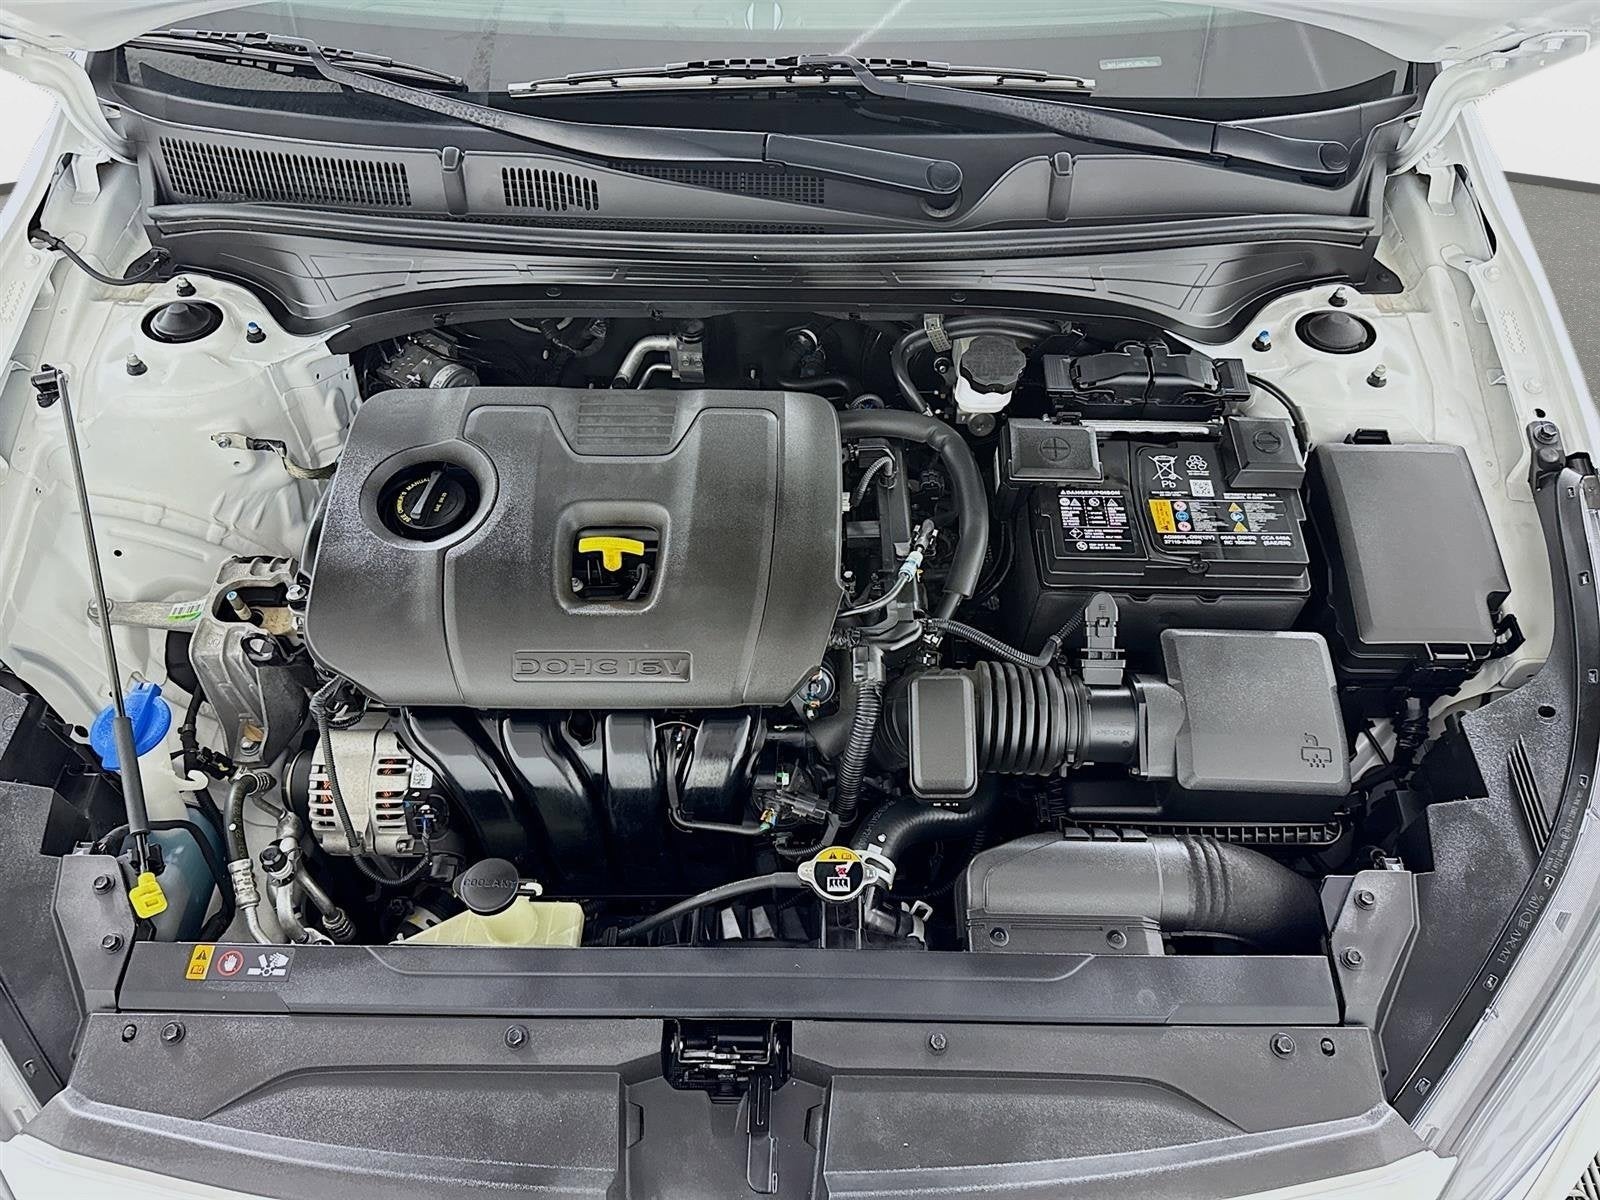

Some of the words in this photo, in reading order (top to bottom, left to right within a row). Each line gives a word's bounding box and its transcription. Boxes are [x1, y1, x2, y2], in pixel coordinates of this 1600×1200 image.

[1161, 480, 1177, 488] Pb
[515, 659, 618, 675] DOHC
[627, 659, 690, 676] 16V
[463, 879, 516, 889] COOLANT
